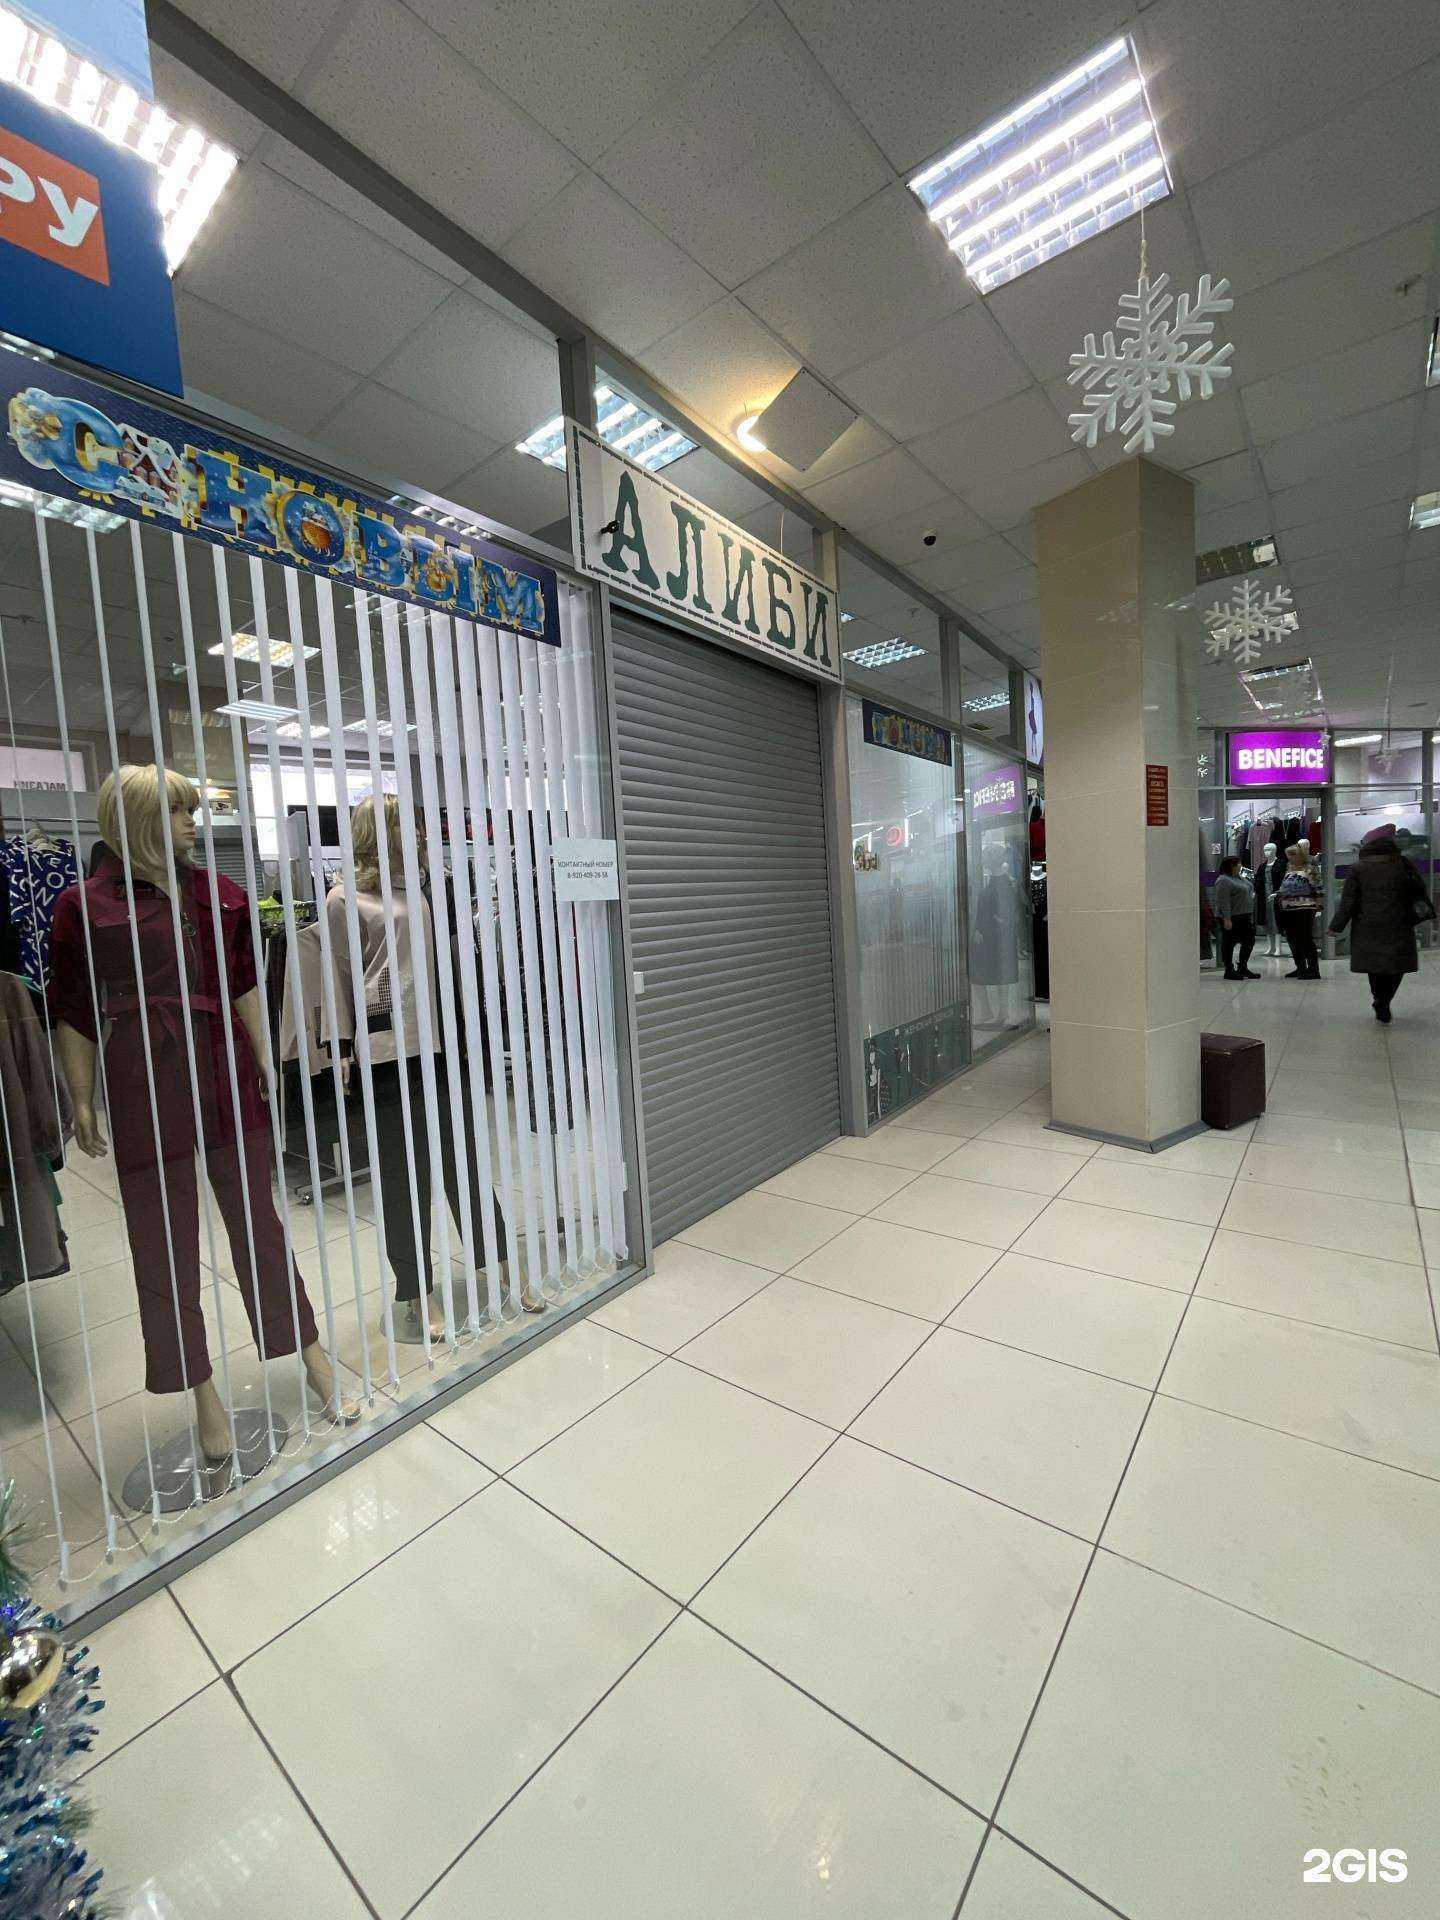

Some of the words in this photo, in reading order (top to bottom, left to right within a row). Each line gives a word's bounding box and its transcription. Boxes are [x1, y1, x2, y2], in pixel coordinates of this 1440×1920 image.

[7, 387, 136, 498] С
[184, 443, 546, 637] НОВЫМ
[601, 470, 832, 667] АЛИБИ
[1238, 747, 1324, 770] BENEFICE
[557, 860, 595, 868] КОНТАКТНЫЙ
